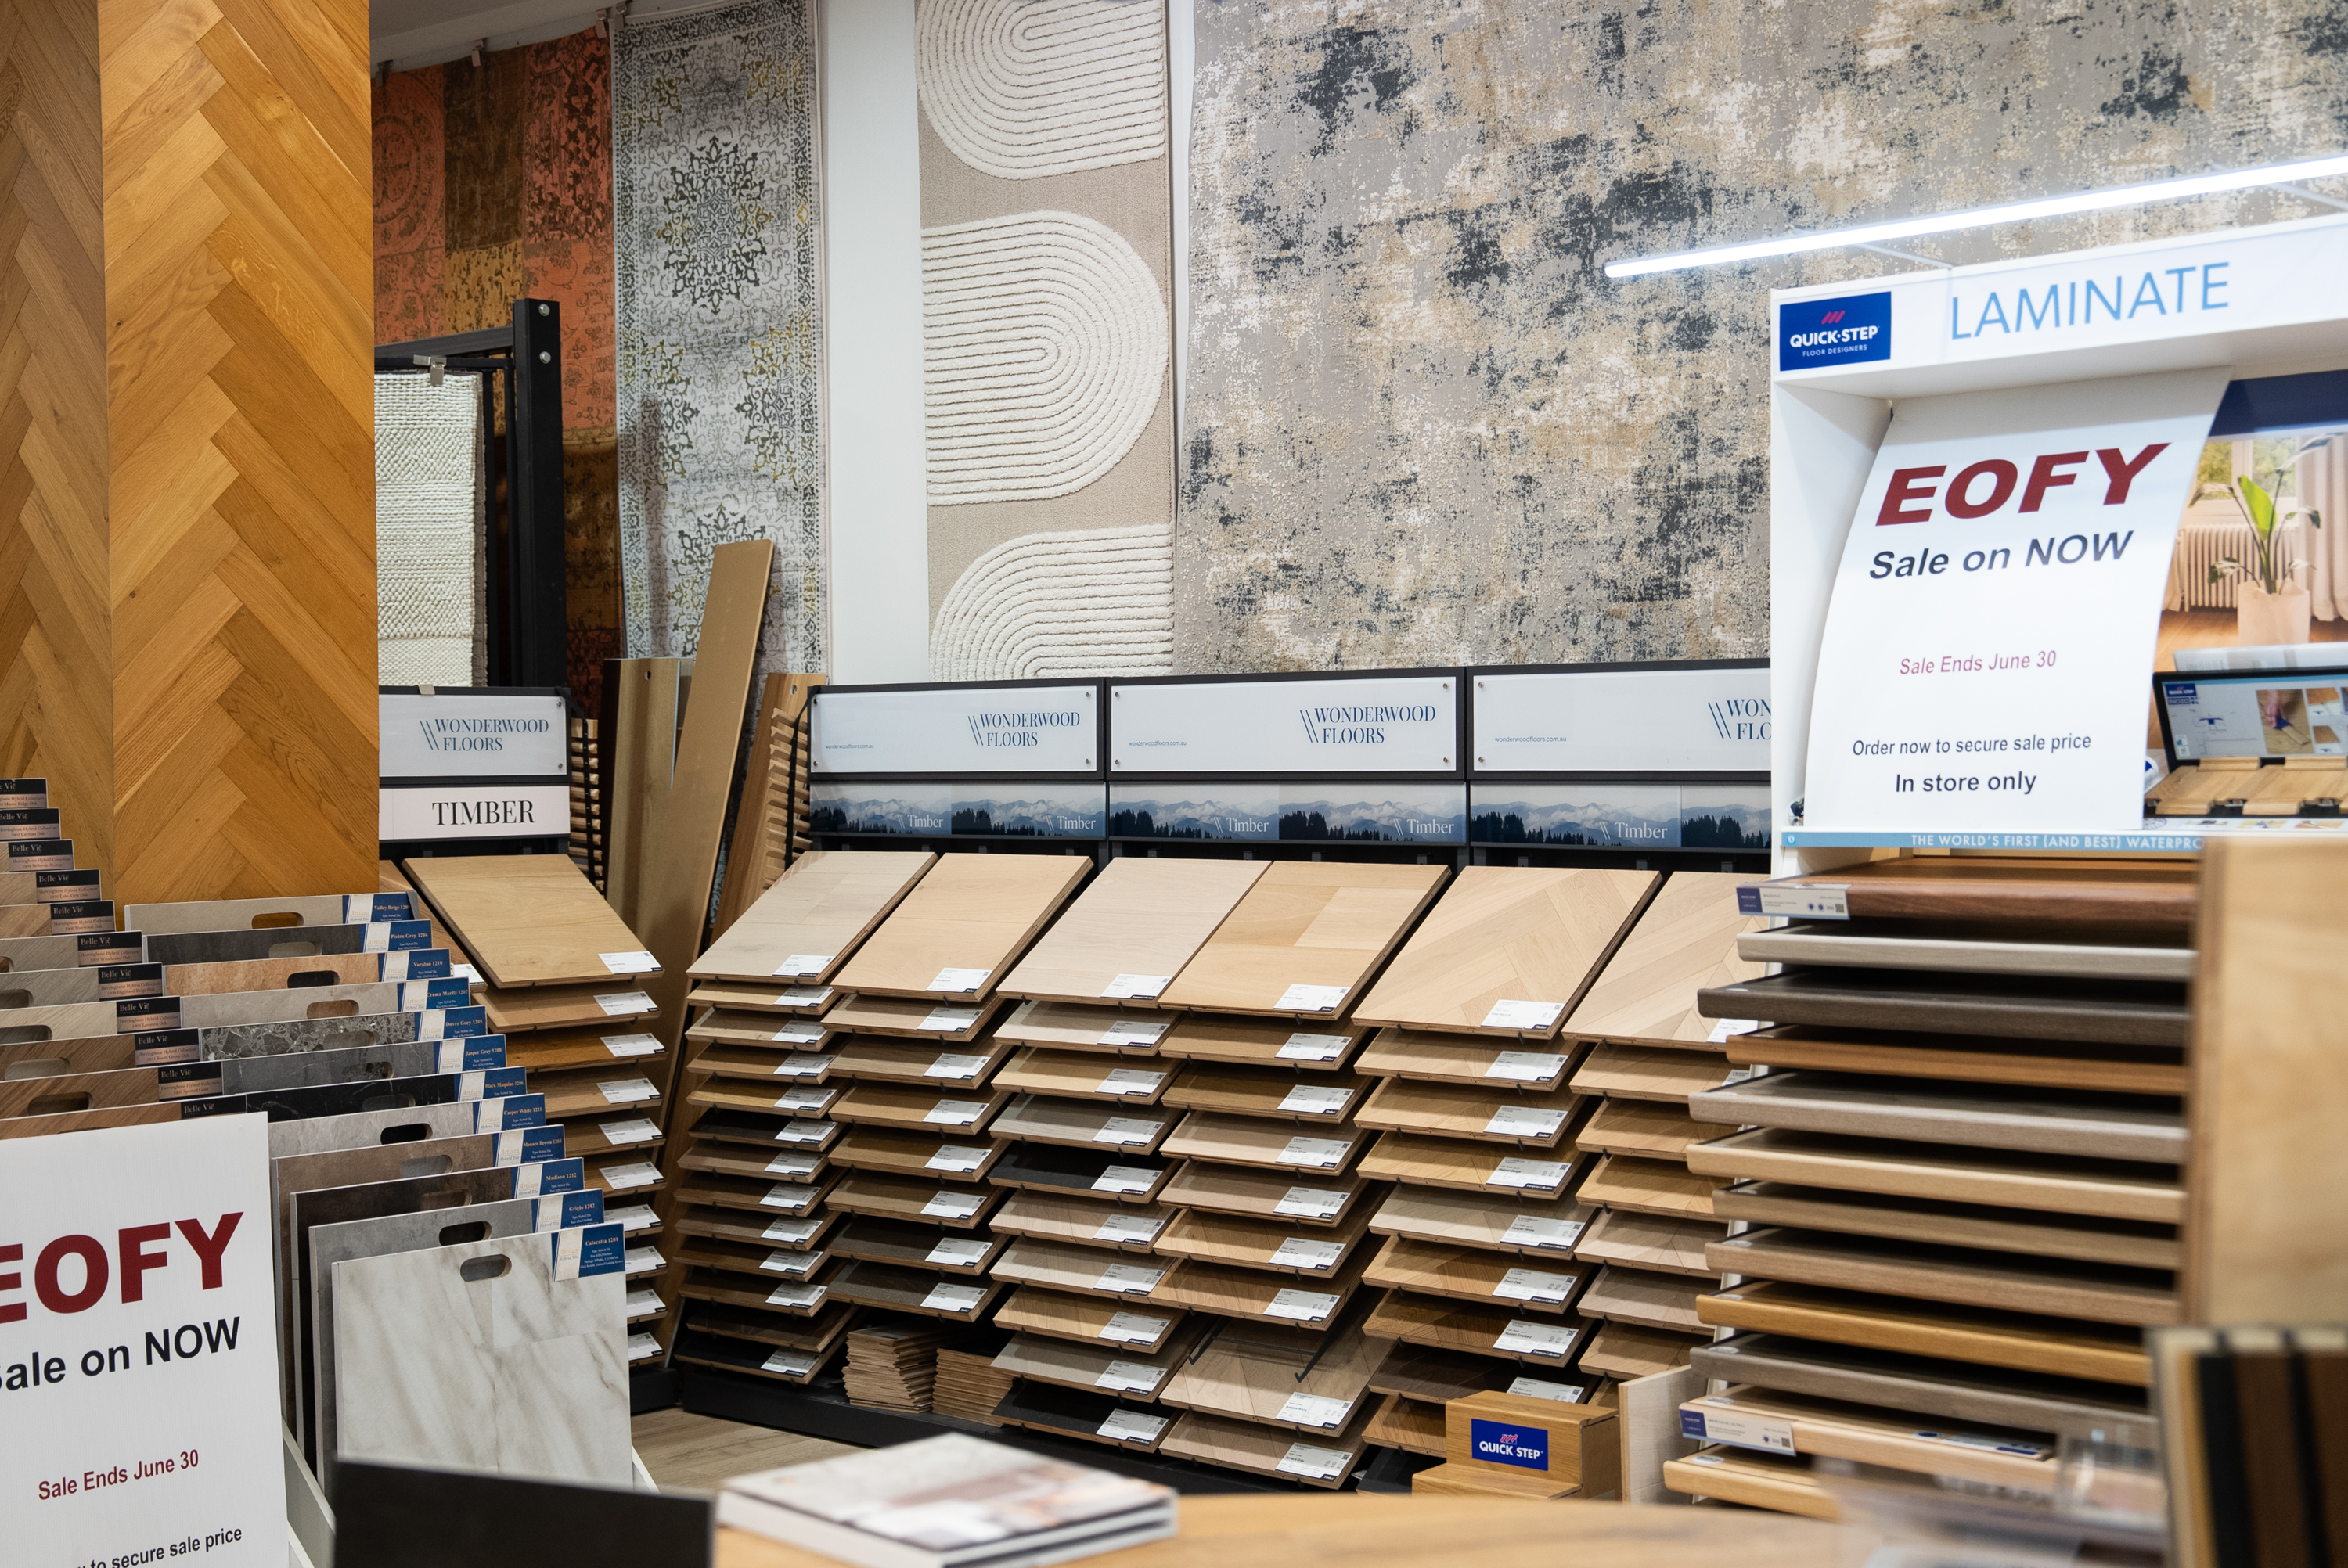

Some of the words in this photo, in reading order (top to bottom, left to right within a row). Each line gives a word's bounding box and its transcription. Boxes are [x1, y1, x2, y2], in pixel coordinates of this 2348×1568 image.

[1952, 262, 2229, 340] LAMINATE
[1802, 347, 1826, 358] FLOOR
[1828, 343, 1867, 355] DESIGNERS
[1875, 442, 2171, 526] EOFY
[1869, 547, 1949, 579] Sale
[1962, 541, 2011, 570] on
[2025, 530, 2134, 566] NOW
[1900, 656, 1935, 675] Sale
[1940, 653, 1982, 673] Ends
[1989, 653, 2030, 671] June
[2036, 650, 2057, 668] 30
[980, 710, 1081, 729] WONDERWOOD
[1314, 704, 1437, 725] WONDERWOOD
[434, 717, 549, 733] WONDERWOOD
[1737, 721, 1771, 741] FLO
[443, 736, 503, 752] FLOORS
[986, 732, 1039, 747] FLOORS
[1127, 739, 1187, 747] wonderwoodfloors.com.au
[1322, 726, 1385, 745] FLOORS
[1853, 738, 1895, 757] Order
[1900, 741, 1931, 755] now
[1935, 738, 1950, 753] to
[1956, 739, 2008, 753] secure
[2014, 734, 2047, 750] sale
[2051, 733, 2091, 753] price
[1895, 773, 1914, 793] In
[1922, 773, 1979, 793] store
[1988, 771, 2037, 795] only
[432, 799, 536, 826] TIMBER
[907, 814, 944, 829] Timber
[1057, 815, 1097, 831] Timber
[1226, 816, 1269, 833] Timber
[1406, 817, 1454, 836] Timber
[1614, 821, 1669, 839] Timber
[1911, 834, 1934, 846] THE
[1938, 834, 2000, 847] WORLD'S
[2004, 835, 2039, 847] FIRST
[2043, 833, 2080, 848] (AND
[2085, 835, 2121, 849] BEST)
[184, 1104, 201, 1113] Belle
[0, 1351, 66, 1392] ale
[81, 1345, 130, 1377] on
[145, 1316, 240, 1366] NOW
[38, 1476, 77, 1501] Sale
[83, 1466, 128, 1491] Ends
[133, 1458, 175, 1481] June
[180, 1448, 199, 1469] 30
[112, 1547, 164, 1568] secure
[169, 1536, 200, 1557] sale
[205, 1528, 243, 1552] price
